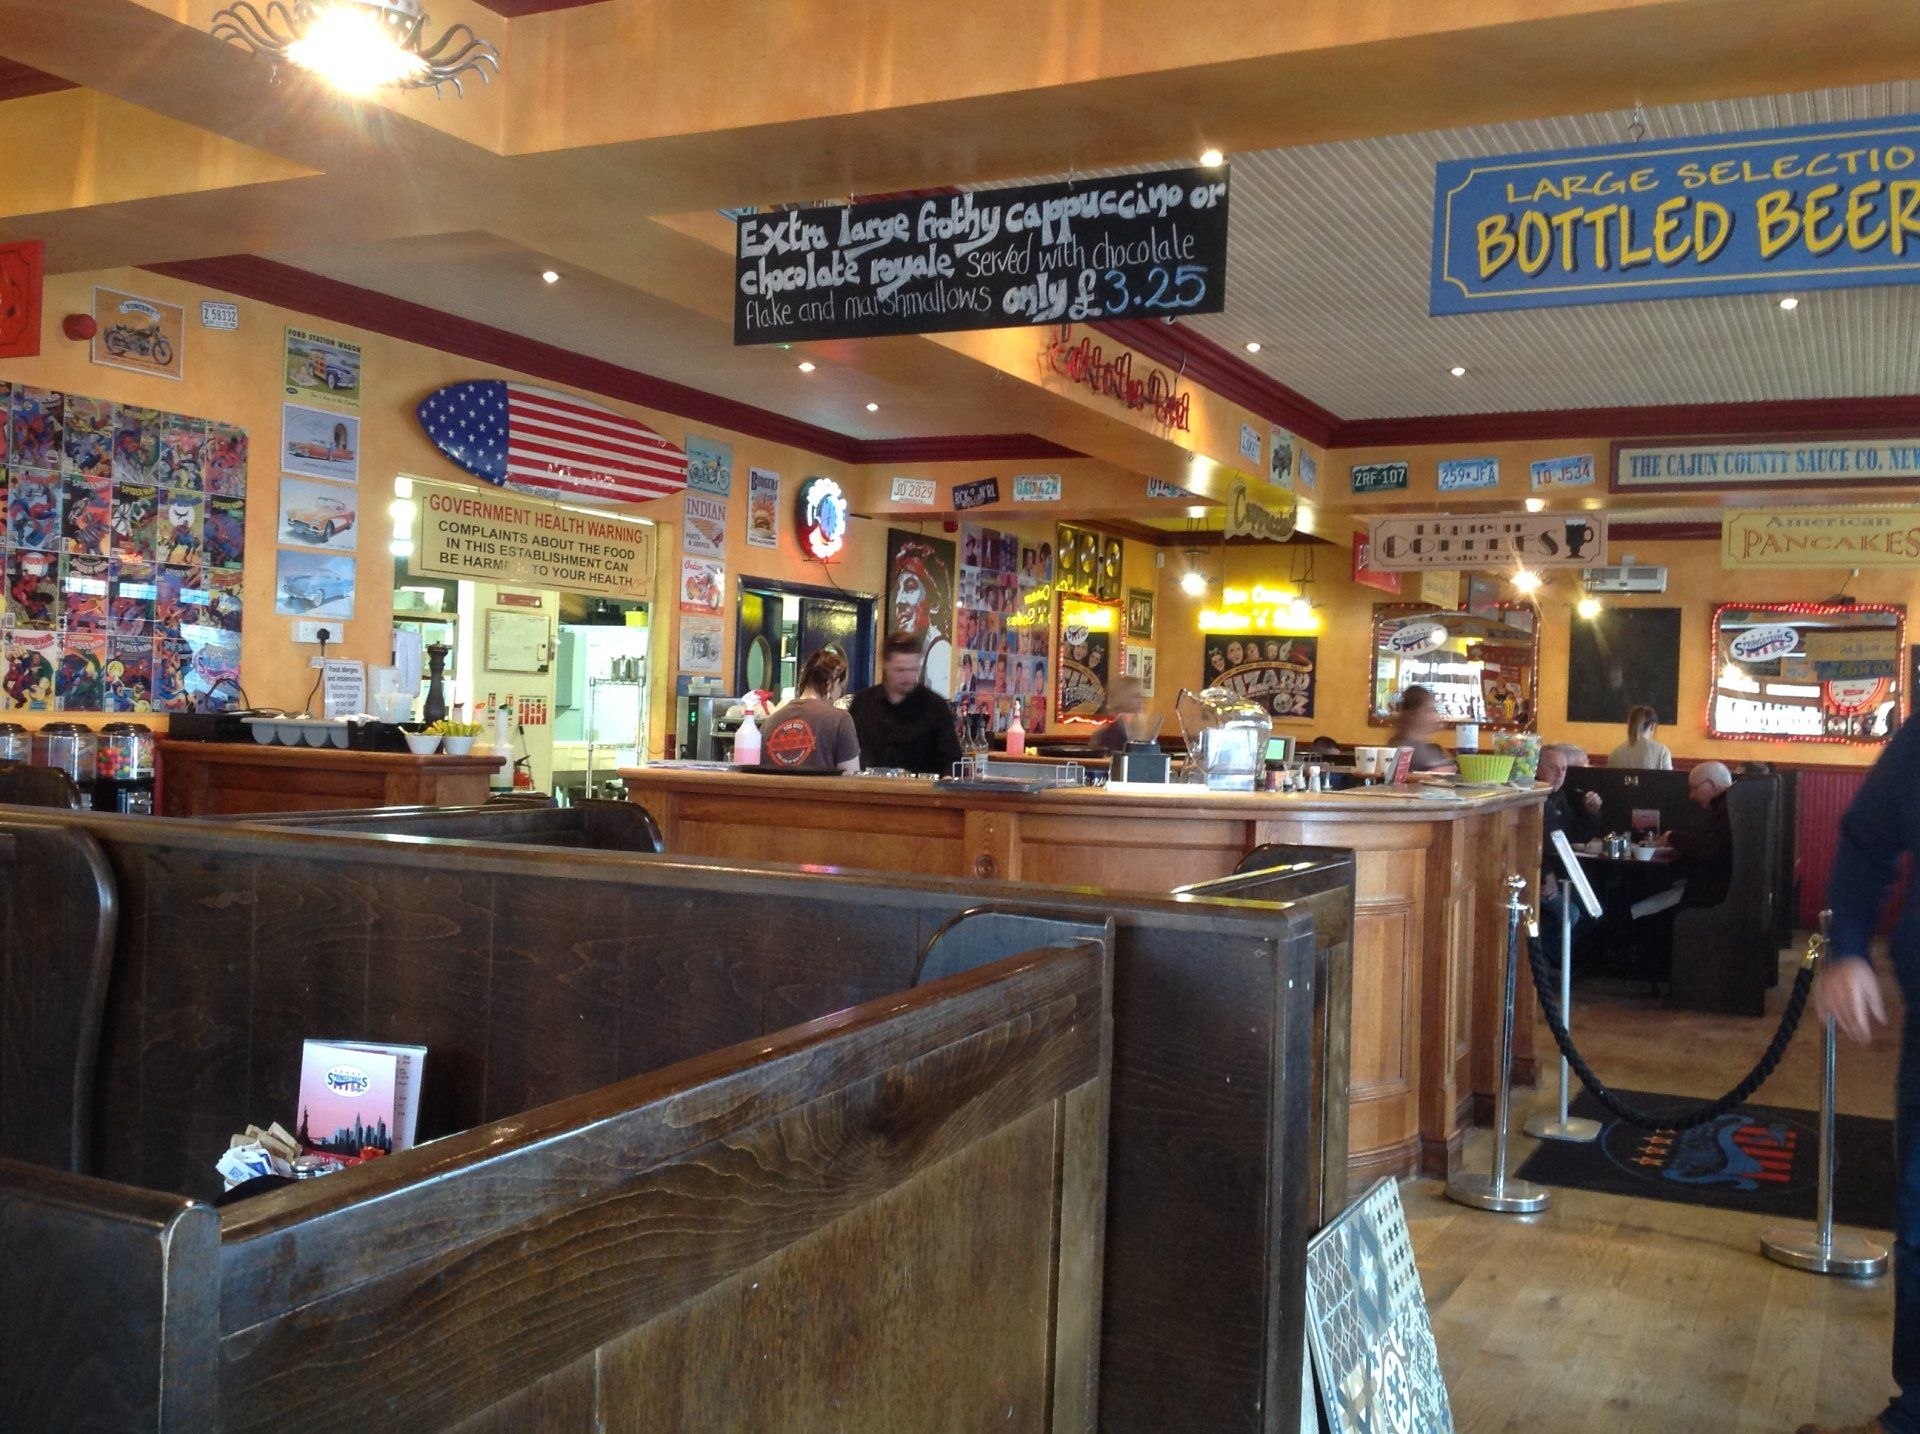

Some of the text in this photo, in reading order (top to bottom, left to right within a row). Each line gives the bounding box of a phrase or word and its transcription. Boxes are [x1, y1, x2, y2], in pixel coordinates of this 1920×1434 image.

[1507, 168, 1659, 203] LARGE
[740, 182, 1226, 262] Extra large frothy cappuccino or
[1476, 197, 1736, 282] BOTTLED
[740, 223, 1195, 300] chocolate royale served with chocolate
[746, 300, 794, 330] flake
[799, 292, 836, 322] and
[844, 280, 992, 318] marshmallows
[1002, 277, 1068, 324] only
[287, 328, 362, 353] FORD STATION WAGON
[1630, 454, 1662, 478] THE
[1666, 452, 1719, 477] CAJUN
[1724, 450, 1790, 475] COUNTY
[1796, 448, 1849, 473] SAUCE
[429, 493, 643, 545] GOVERNMENT HEALTH WARNING
[687, 498, 726, 521] INDIAN
[1767, 516, 1893, 529] American
[438, 520, 636, 561] COMPLAINTS ABOUT THE FOOD
[446, 537, 629, 573] IN THIS ESTABLISHMENT CAN
[439, 551, 460, 566] BE
[532, 563, 549, 577] TO
[552, 565, 586, 583] YOUR
[589, 571, 633, 588] HEALTH
